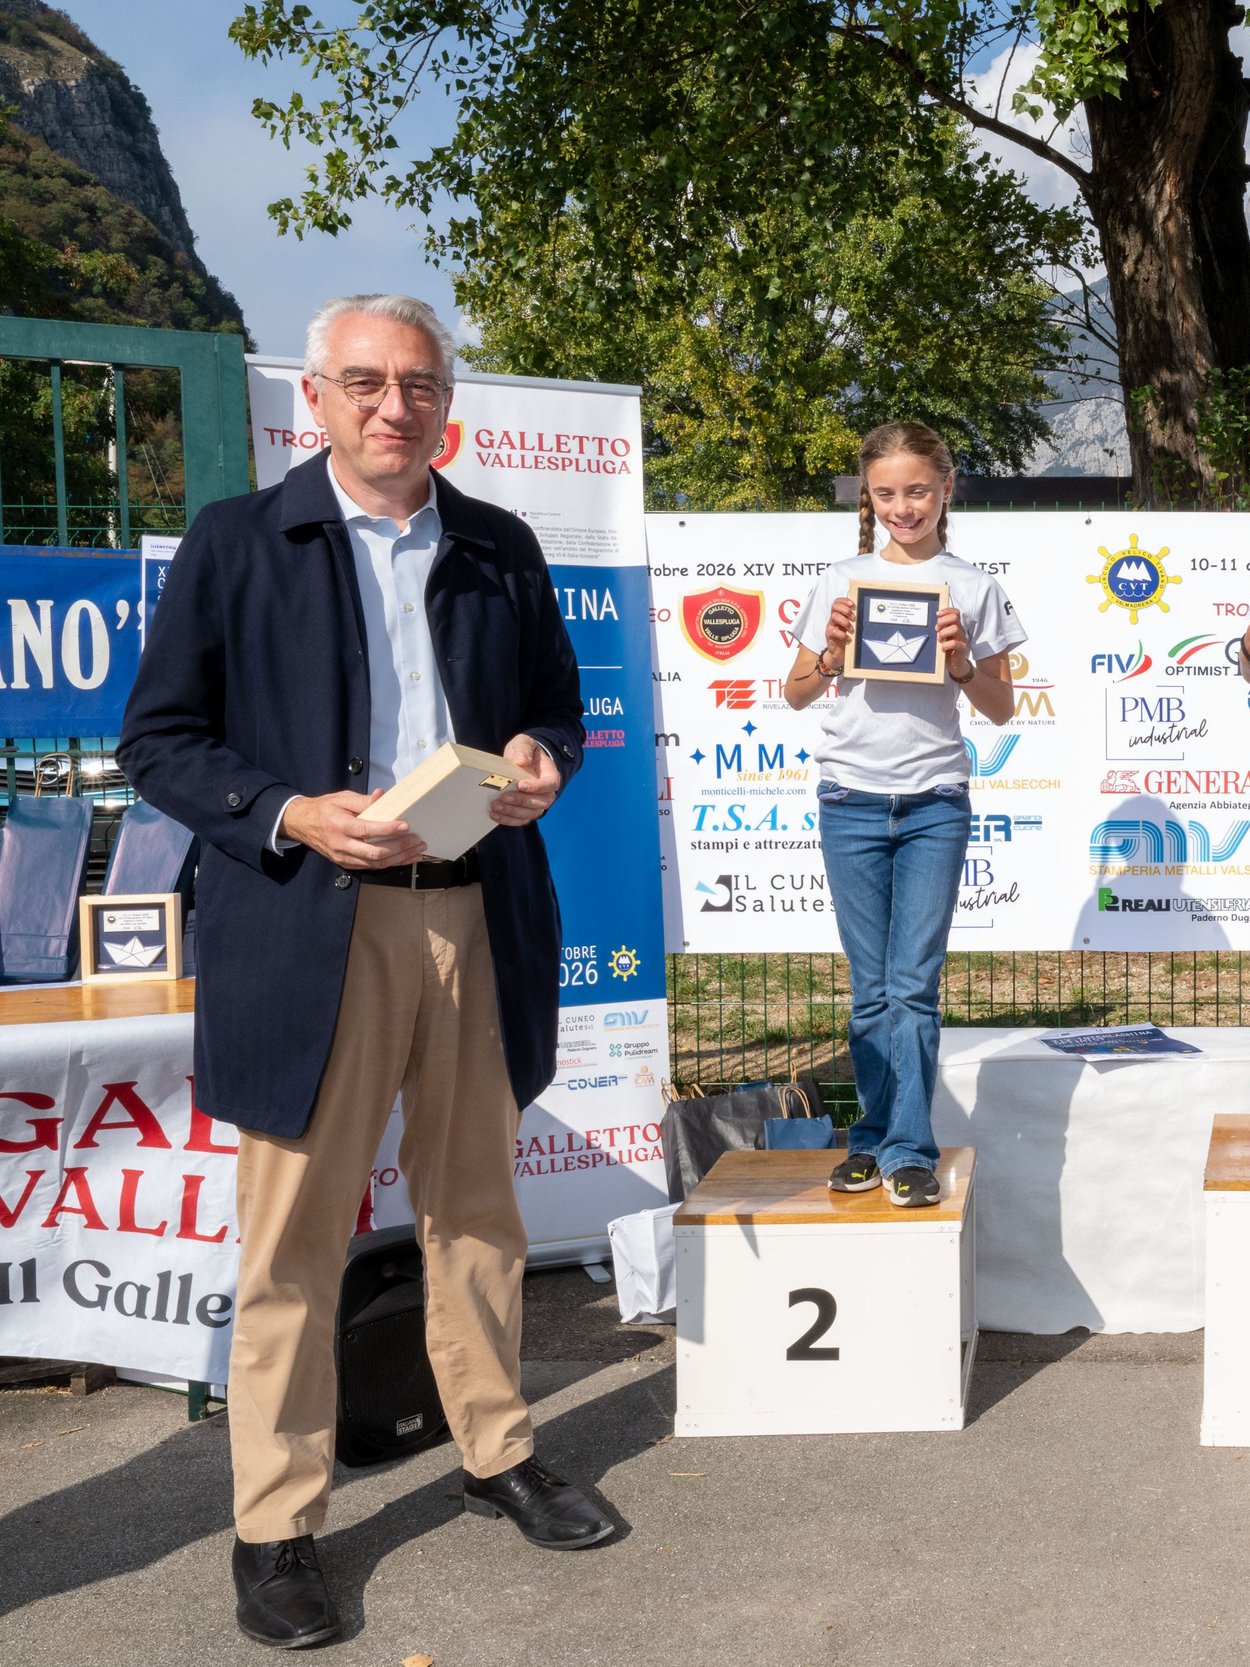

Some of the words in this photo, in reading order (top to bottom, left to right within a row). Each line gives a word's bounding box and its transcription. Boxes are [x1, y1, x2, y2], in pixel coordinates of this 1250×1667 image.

[475, 429, 631, 458] GALLETTO
[476, 452, 632, 475] VALLESPLUGA
[1121, 549, 1152, 560] VELICO
[696, 563, 736, 577] 2026
[743, 563, 775, 576] XIV
[782, 563, 831, 576] INTE
[1190, 558, 1237, 572] 10-11
[1102, 556, 1116, 590] CIRCOLO
[1155, 562, 1165, 590] TIVANO
[1118, 582, 1149, 591] CVT
[555, 587, 619, 620] INA
[708, 605, 735, 615] GALLETTO
[1115, 599, 1153, 609] VALMADRERA
[705, 627, 719, 641] VALLE
[721, 626, 740, 641] SPLUGA
[1091, 654, 1135, 674] FIV
[1165, 666, 1231, 677] OPTIMIST
[1120, 697, 1186, 723] PMB
[1129, 719, 1209, 748] industrial
[736, 769, 772, 782] since
[778, 768, 810, 781] 1961
[701, 786, 807, 796] monticelli-michele.com
[988, 779, 1061, 790] VALSECCHI
[1169, 801, 1207, 811] Agenzia
[691, 804, 788, 832] T.S.A.
[690, 838, 739, 853] stampi
[743, 842, 751, 850] e
[1089, 865, 1161, 876] STAMPERIA
[1164, 865, 1217, 876] METALLI
[734, 874, 757, 890] IL
[1122, 898, 1171, 912] REALI
[1191, 914, 1229, 922] Paderno
[562, 945, 597, 960] OBRE
[566, 1015, 595, 1024] CUNEO
[624, 1041, 649, 1050] Gruppo
[624, 1048, 658, 1057] Pulidream
[62, 1259, 233, 1329] Galle
[786, 1287, 840, 1361] 2
